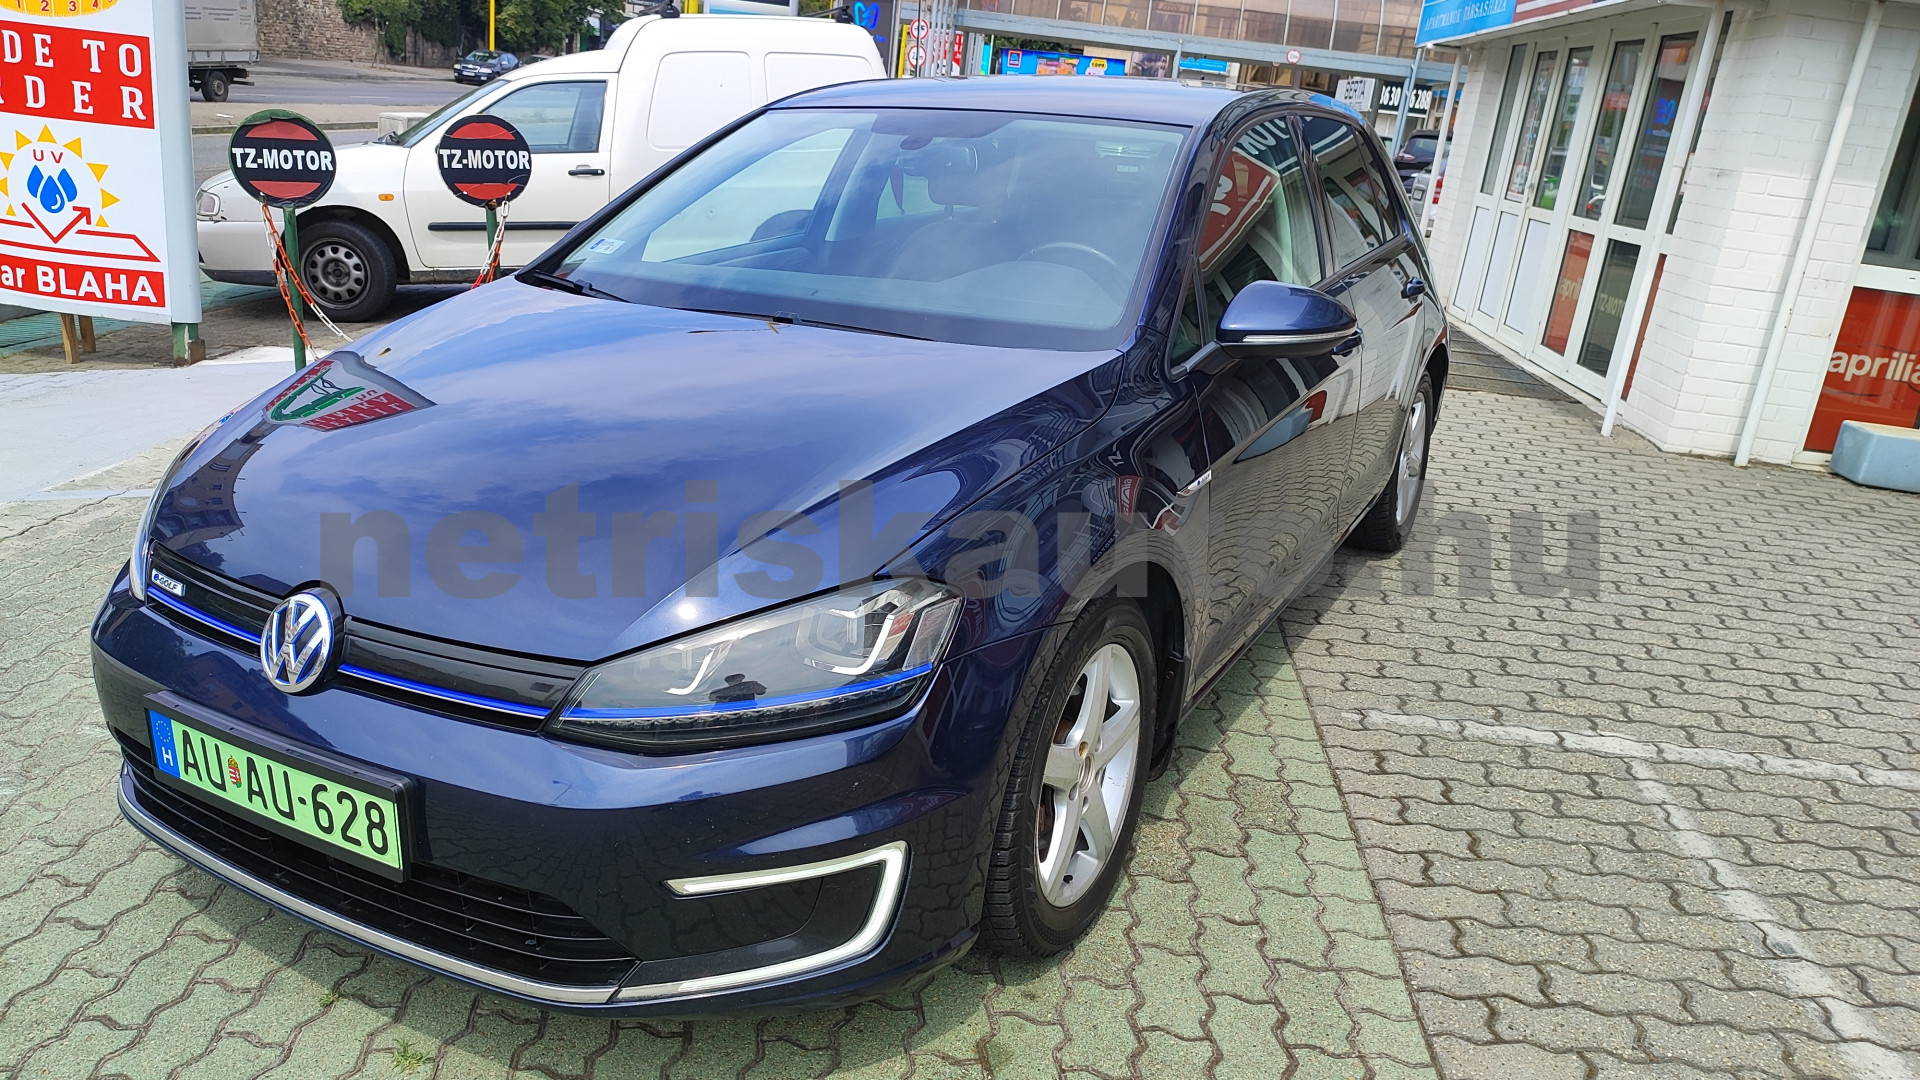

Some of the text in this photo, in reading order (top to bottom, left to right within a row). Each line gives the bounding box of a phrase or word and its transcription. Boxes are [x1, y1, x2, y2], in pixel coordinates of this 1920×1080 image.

[40, 0, 50, 11] 2
[69, 0, 77, 11] 3
[1, 29, 142, 77] DE TO
[0, 75, 147, 120] DER
[1344, 80, 1366, 100] BERTA
[231, 147, 335, 171] TZ-MOTOR
[439, 149, 530, 170] TZ-MOTOR
[36, 265, 158, 303] BLAHA
[161, 746, 174, 767] H
[181, 729, 389, 855] AU AU-628
